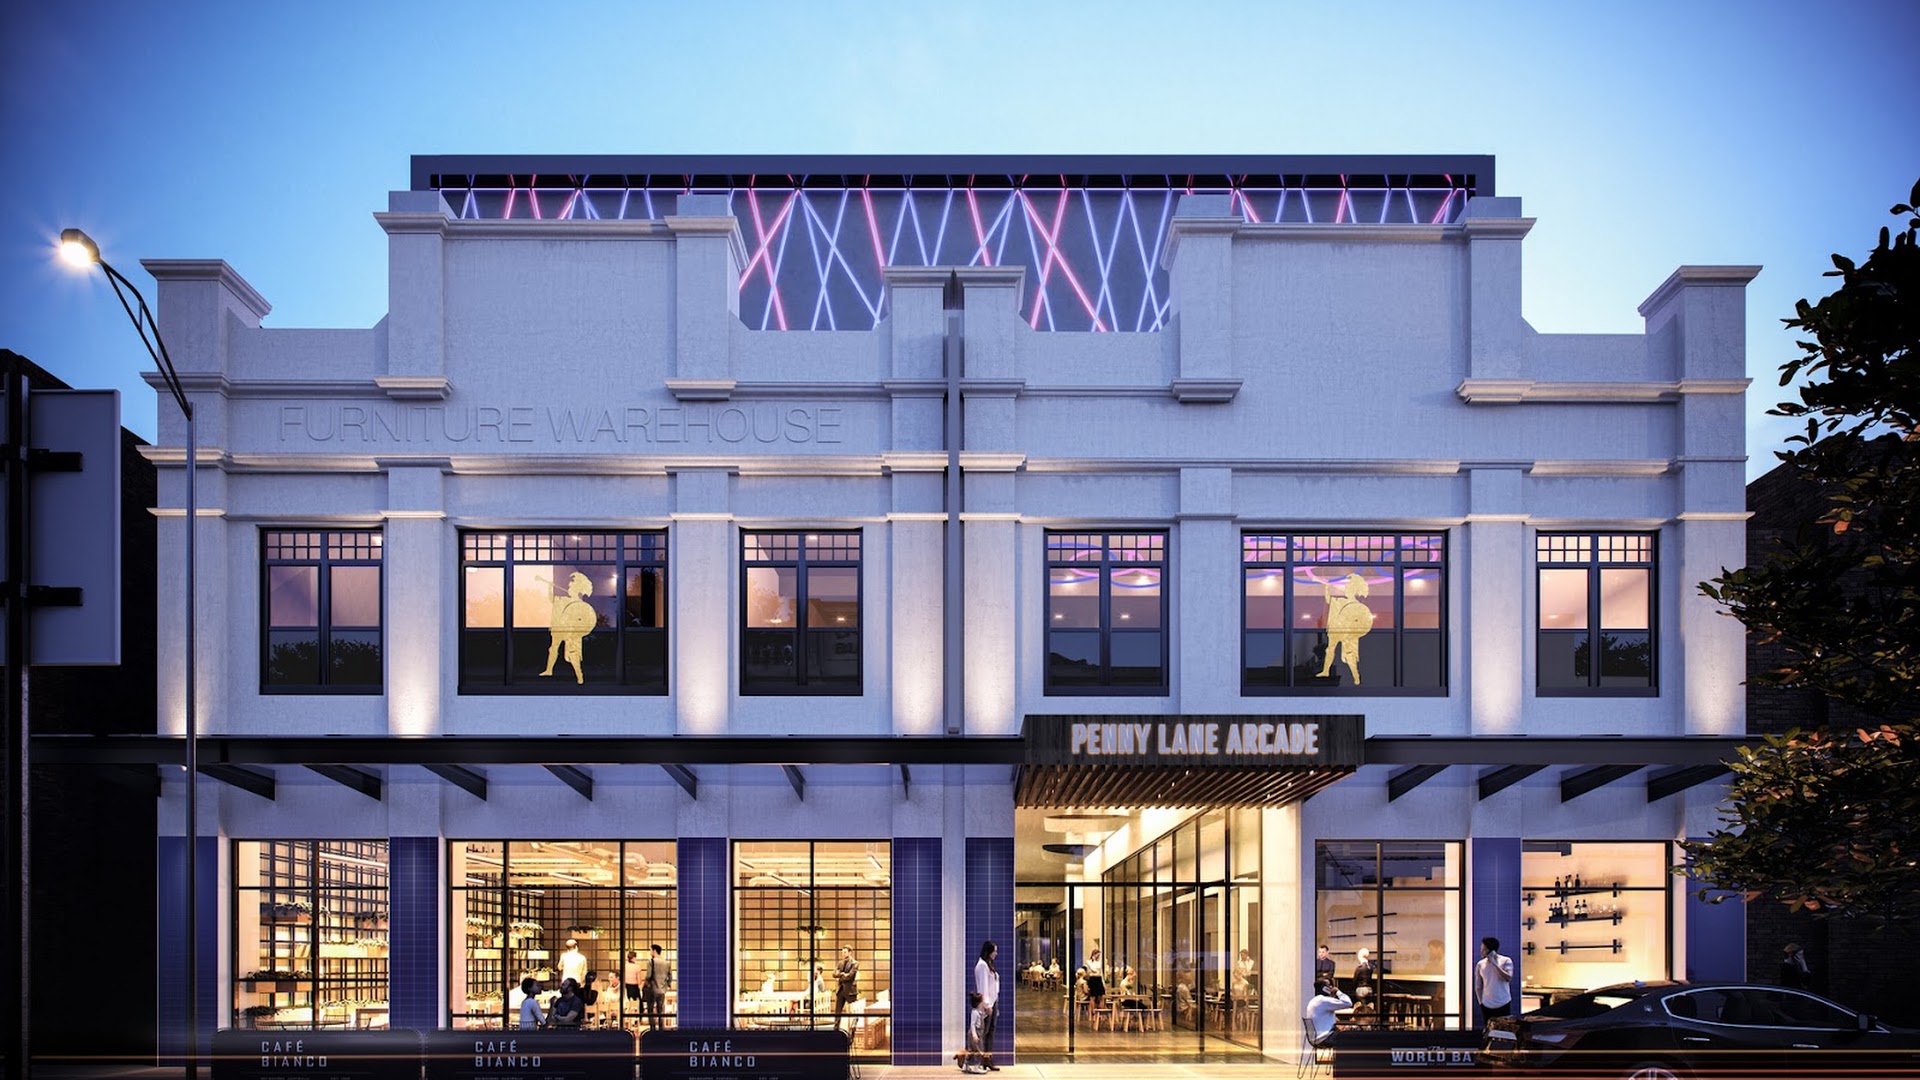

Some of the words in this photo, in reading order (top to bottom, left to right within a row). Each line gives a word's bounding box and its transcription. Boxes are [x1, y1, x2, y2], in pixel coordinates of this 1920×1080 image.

[279, 406, 535, 443] FURNITURE
[546, 406, 843, 443] WAREHOUSE
[1071, 723, 1152, 755] PENNY
[1157, 723, 1219, 755] LANE
[1225, 723, 1320, 755] ARCADE
[261, 1040, 304, 1053] CAFÉ
[474, 1040, 518, 1053] CAFÉ
[689, 1040, 732, 1053] CAFÉ
[261, 1055, 328, 1068] BIANCO
[474, 1055, 542, 1068] BIANCO
[689, 1055, 756, 1068] BIANCO
[1391, 1051, 1446, 1062] WORLD
[1451, 1051, 1477, 1062] BA
